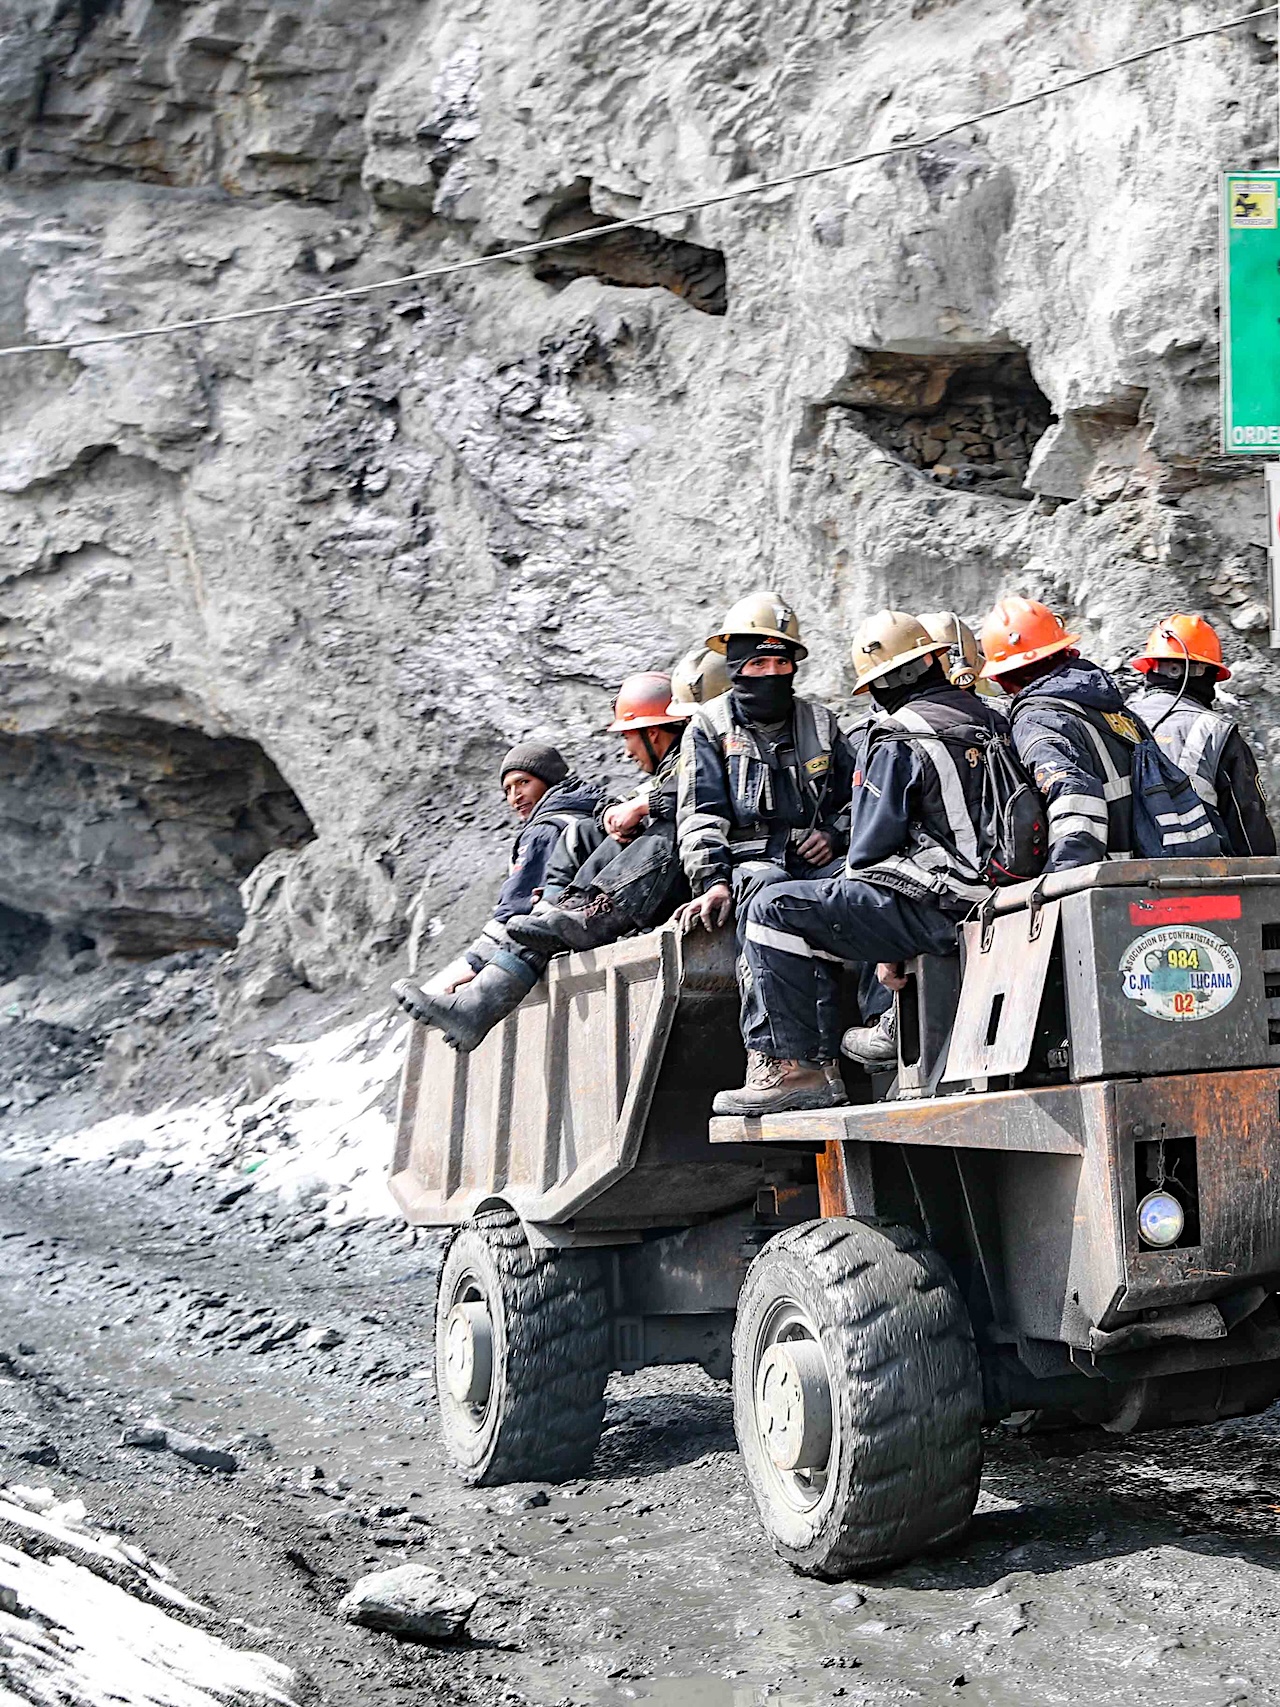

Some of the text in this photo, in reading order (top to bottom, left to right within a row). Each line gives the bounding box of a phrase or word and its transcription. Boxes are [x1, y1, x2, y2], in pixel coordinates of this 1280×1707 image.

[1159, 933, 1168, 943] DE
[1214, 944, 1235, 970] LUCERO
[1168, 949, 1199, 969] 984
[1190, 972, 1233, 989] LUCANA
[1174, 993, 1194, 1012] 02
